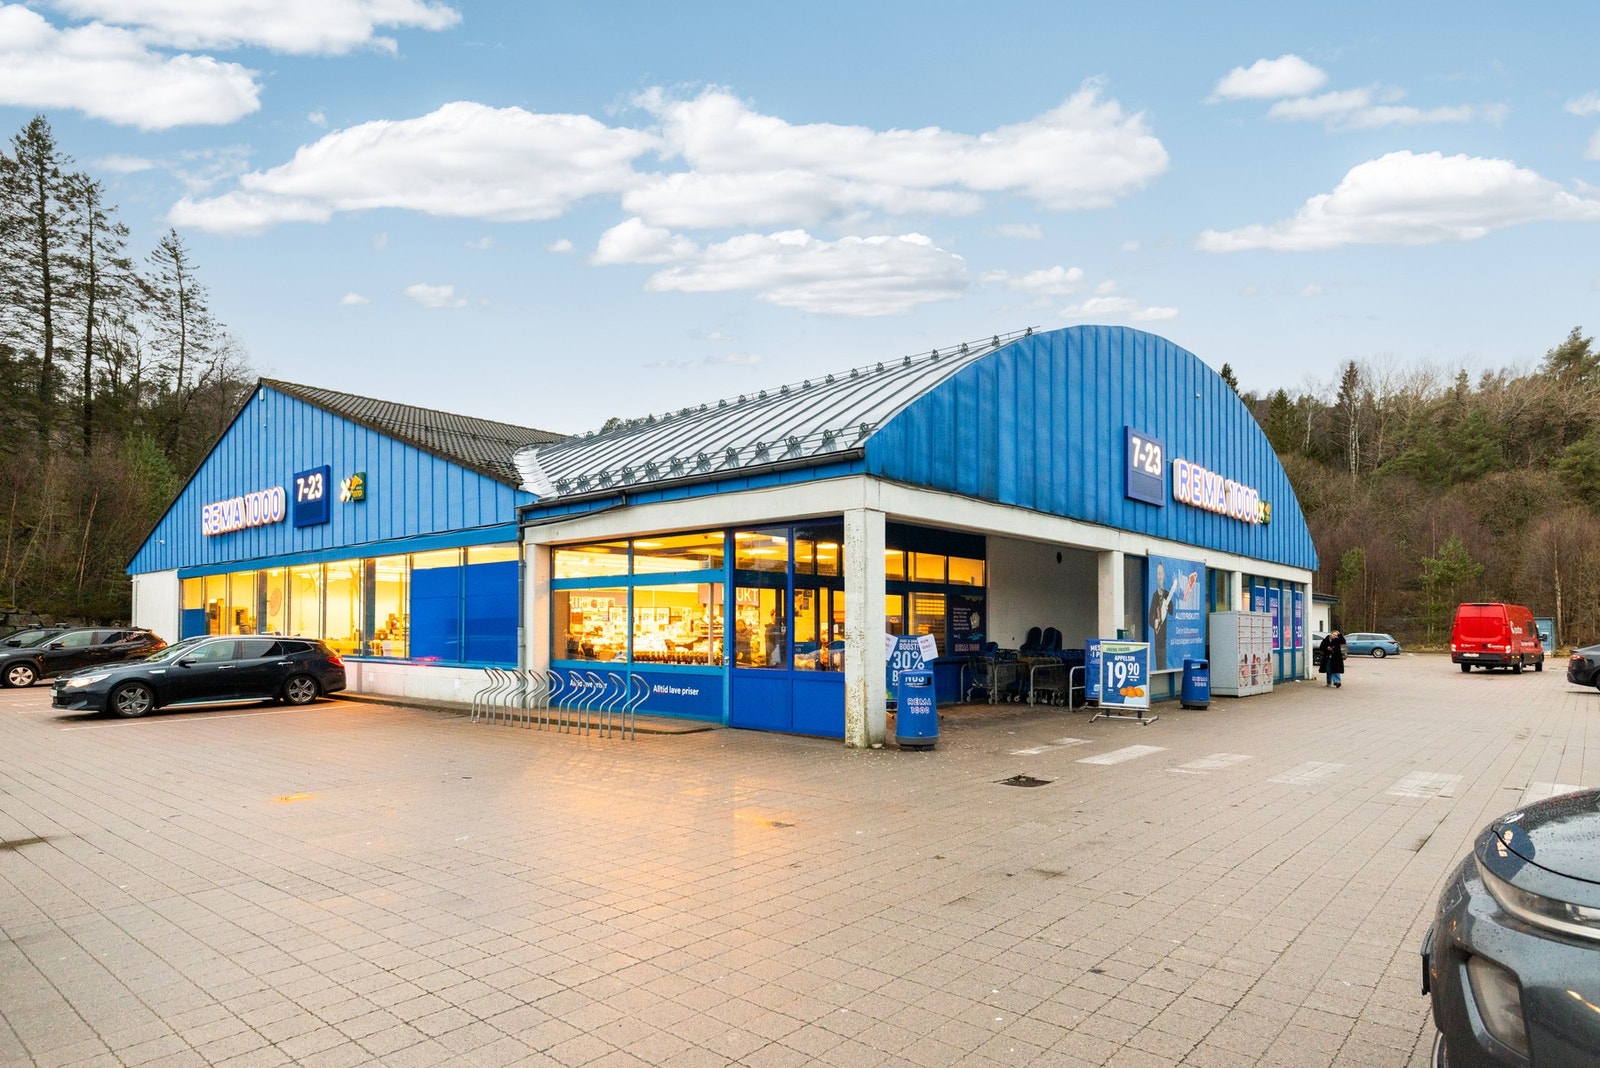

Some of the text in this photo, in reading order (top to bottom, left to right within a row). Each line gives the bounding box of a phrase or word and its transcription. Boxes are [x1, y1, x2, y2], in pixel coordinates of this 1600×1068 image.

[1132, 437, 1162, 476] 7-23
[297, 473, 323, 502] 7-23
[1175, 458, 1260, 524] REMA 1000
[202, 486, 285, 536] REMA 1000
[892, 650, 925, 670] 30%
[1106, 661, 1140, 688] 19 90
[652, 684, 700, 696] Alltid lave priser
[906, 697, 932, 706] REMA
